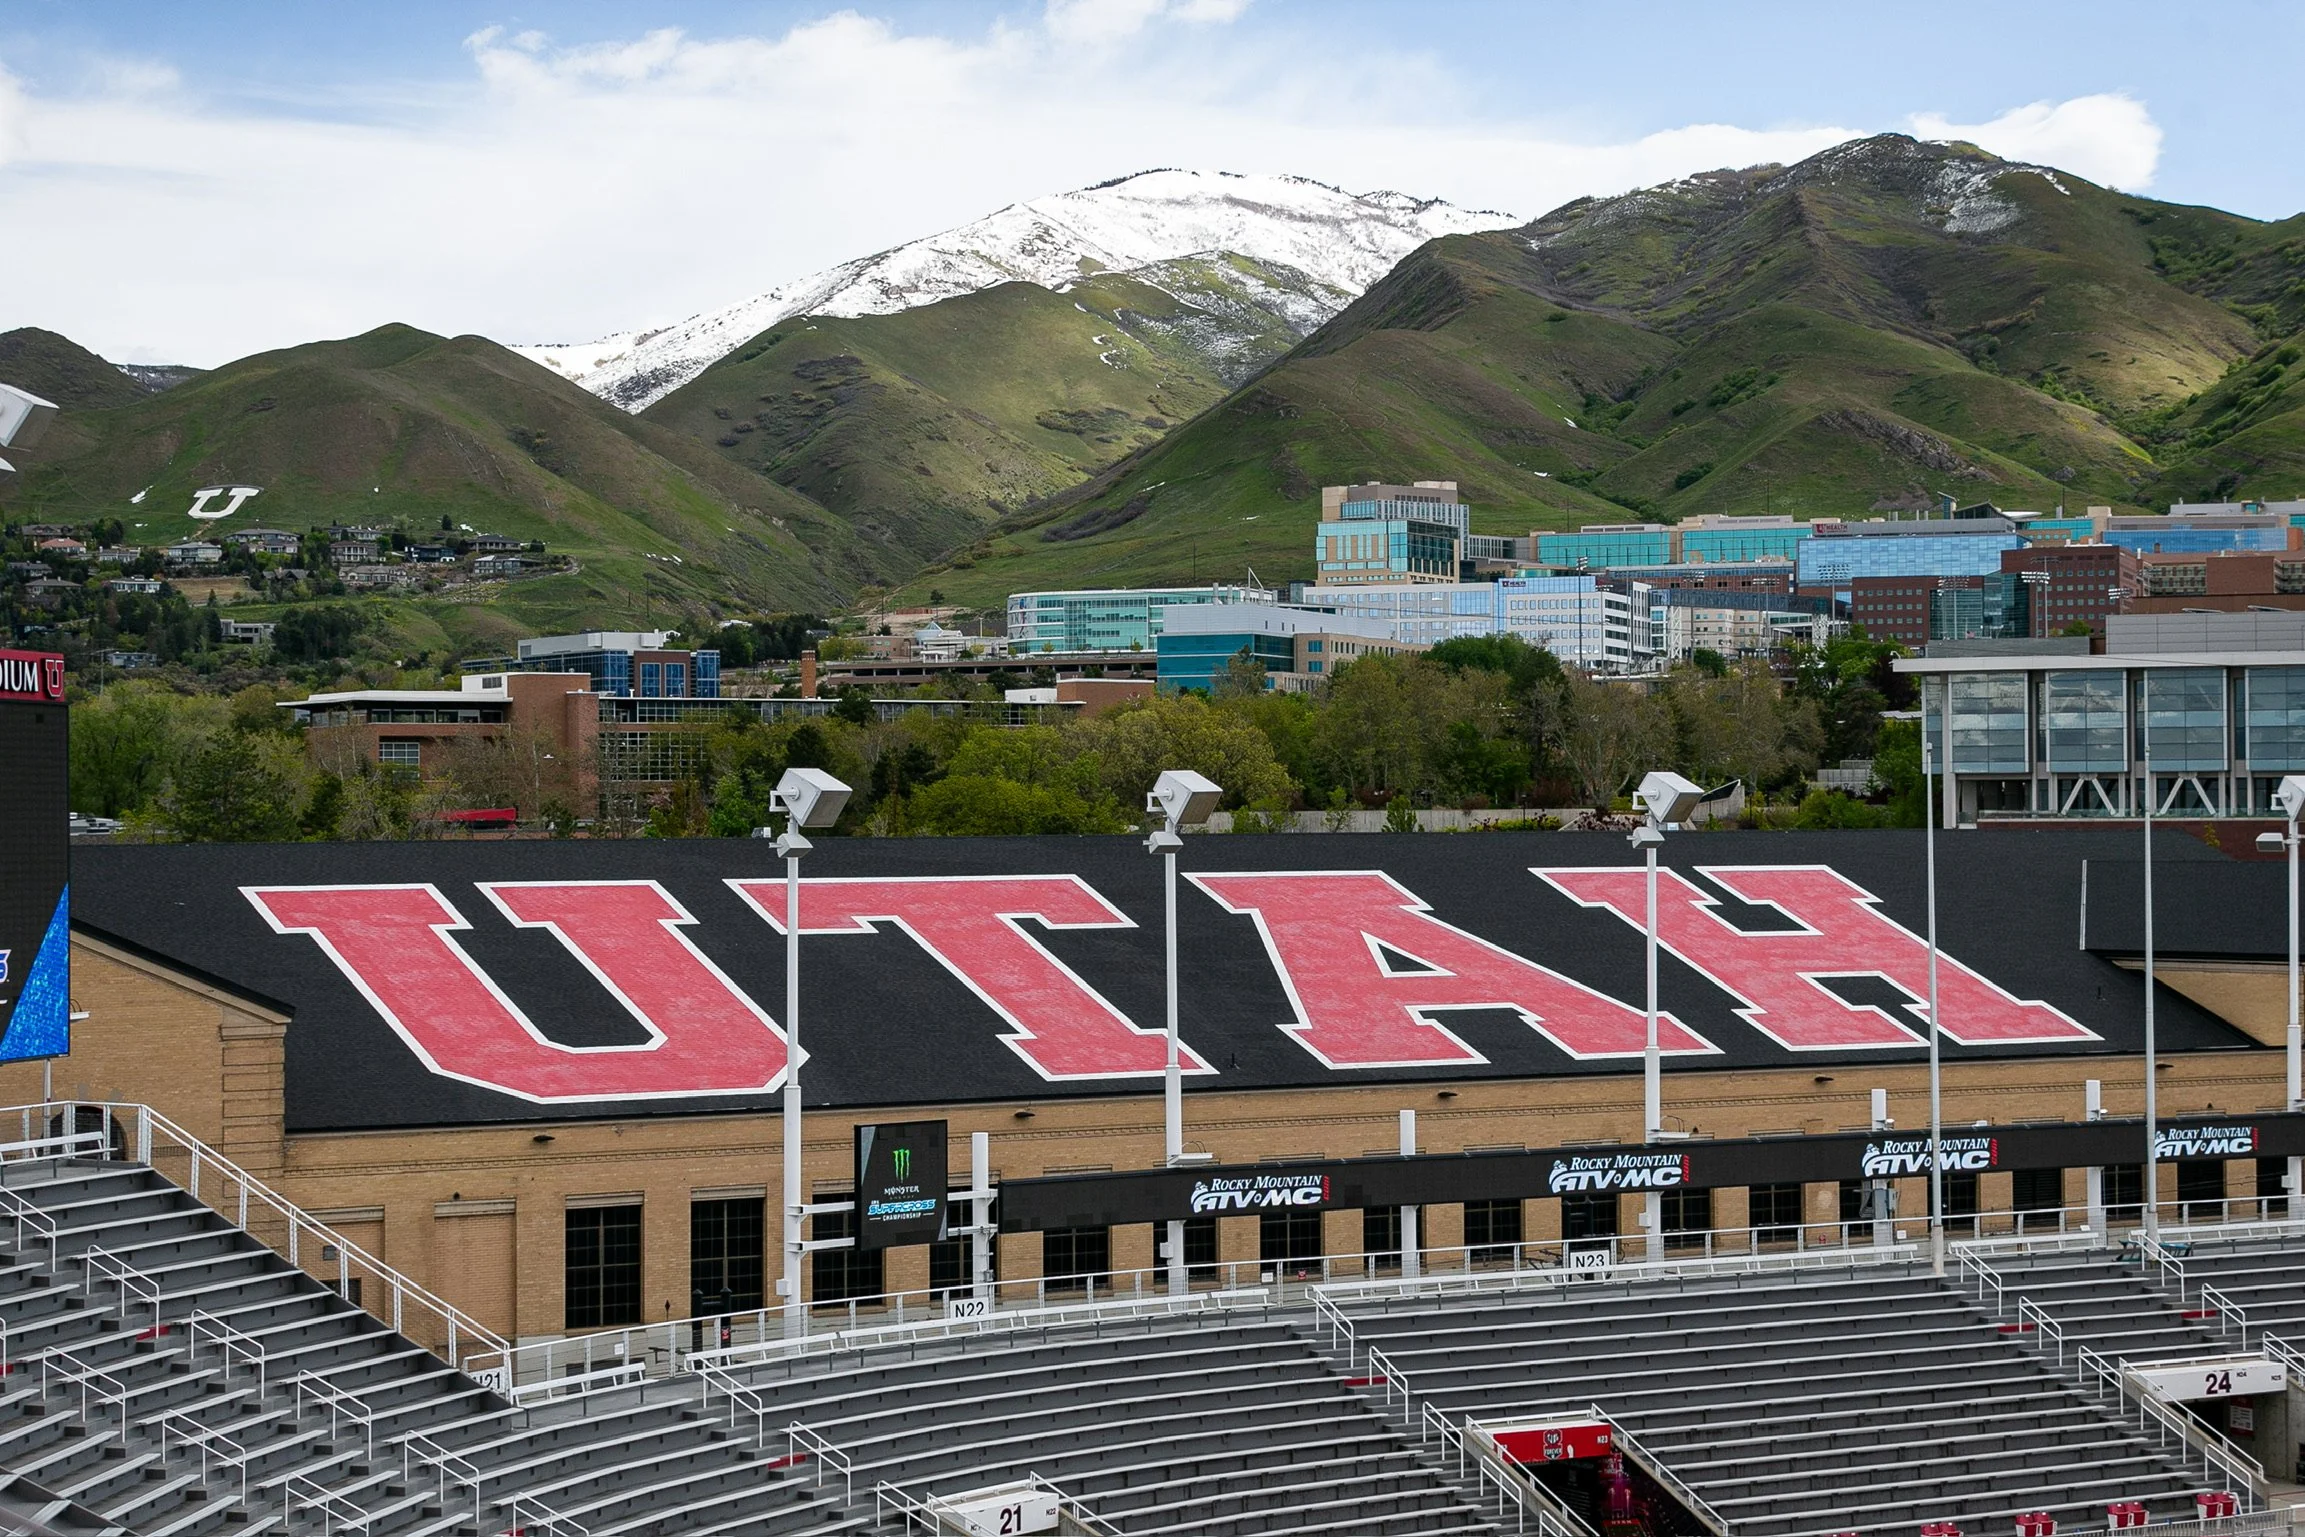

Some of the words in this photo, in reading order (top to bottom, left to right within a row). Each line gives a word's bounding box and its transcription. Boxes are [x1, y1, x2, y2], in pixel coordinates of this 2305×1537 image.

[188, 487, 259, 519] U
[0, 659, 39, 692] IUM
[238, 864, 2106, 1105] UTAH
[2168, 1127, 2200, 1141] ROCKY
[2201, 1126, 2252, 1139] MOUNTAIN
[1882, 1140, 1923, 1154] ROCKY
[1570, 1157, 1612, 1171] ROCKY
[1613, 1154, 1682, 1169] MOUNTAIN
[884, 1185, 920, 1196] MONSTER
[1211, 1178, 1252, 1191] ROCKY
[1253, 1175, 1322, 1189] MOUNTAIN
[867, 1199, 937, 1216] SUPERCROSS
[882, 1212, 922, 1221] CHAMPIONSHIP
[1576, 1253, 1605, 1268] N23
[955, 1301, 985, 1318] N22
[2205, 1371, 2232, 1395] 24
[1000, 1505, 1022, 1536] 21
